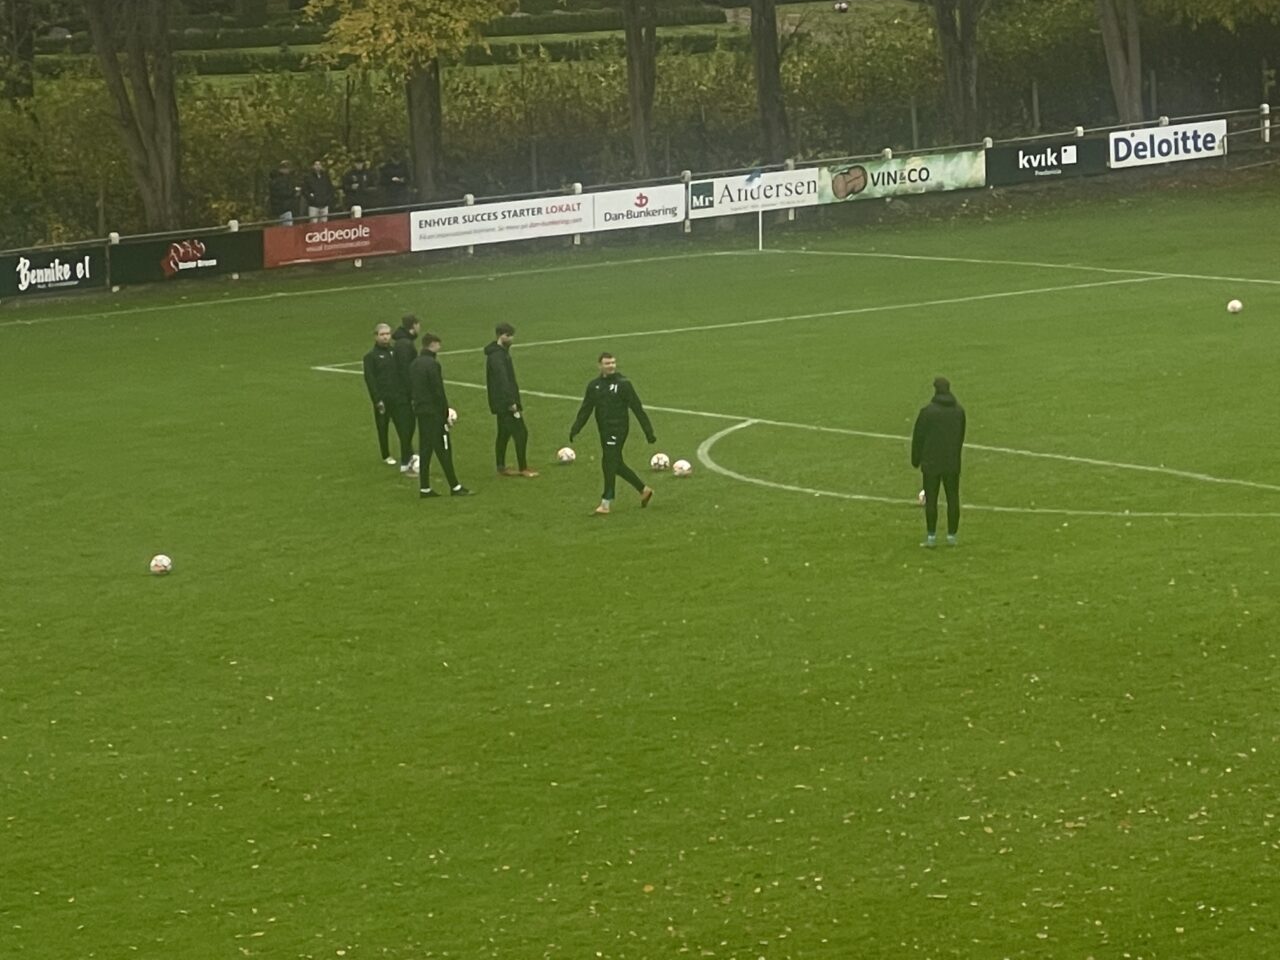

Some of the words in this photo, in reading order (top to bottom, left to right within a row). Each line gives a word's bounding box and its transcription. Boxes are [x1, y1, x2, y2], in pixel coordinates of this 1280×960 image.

[1114, 130, 1216, 162] Deloitte
[1018, 147, 1058, 169] kvik
[692, 195, 714, 208] Mr
[419, 216, 459, 228] ENHVER
[462, 211, 498, 224] SUCCES
[501, 207, 543, 219] STARTER
[545, 202, 581, 214] LOKALT
[604, 206, 677, 222] Dan-Bunkering
[305, 224, 370, 243] cadpeople
[16, 257, 71, 290] Bennike
[76, 256, 90, 278] el
